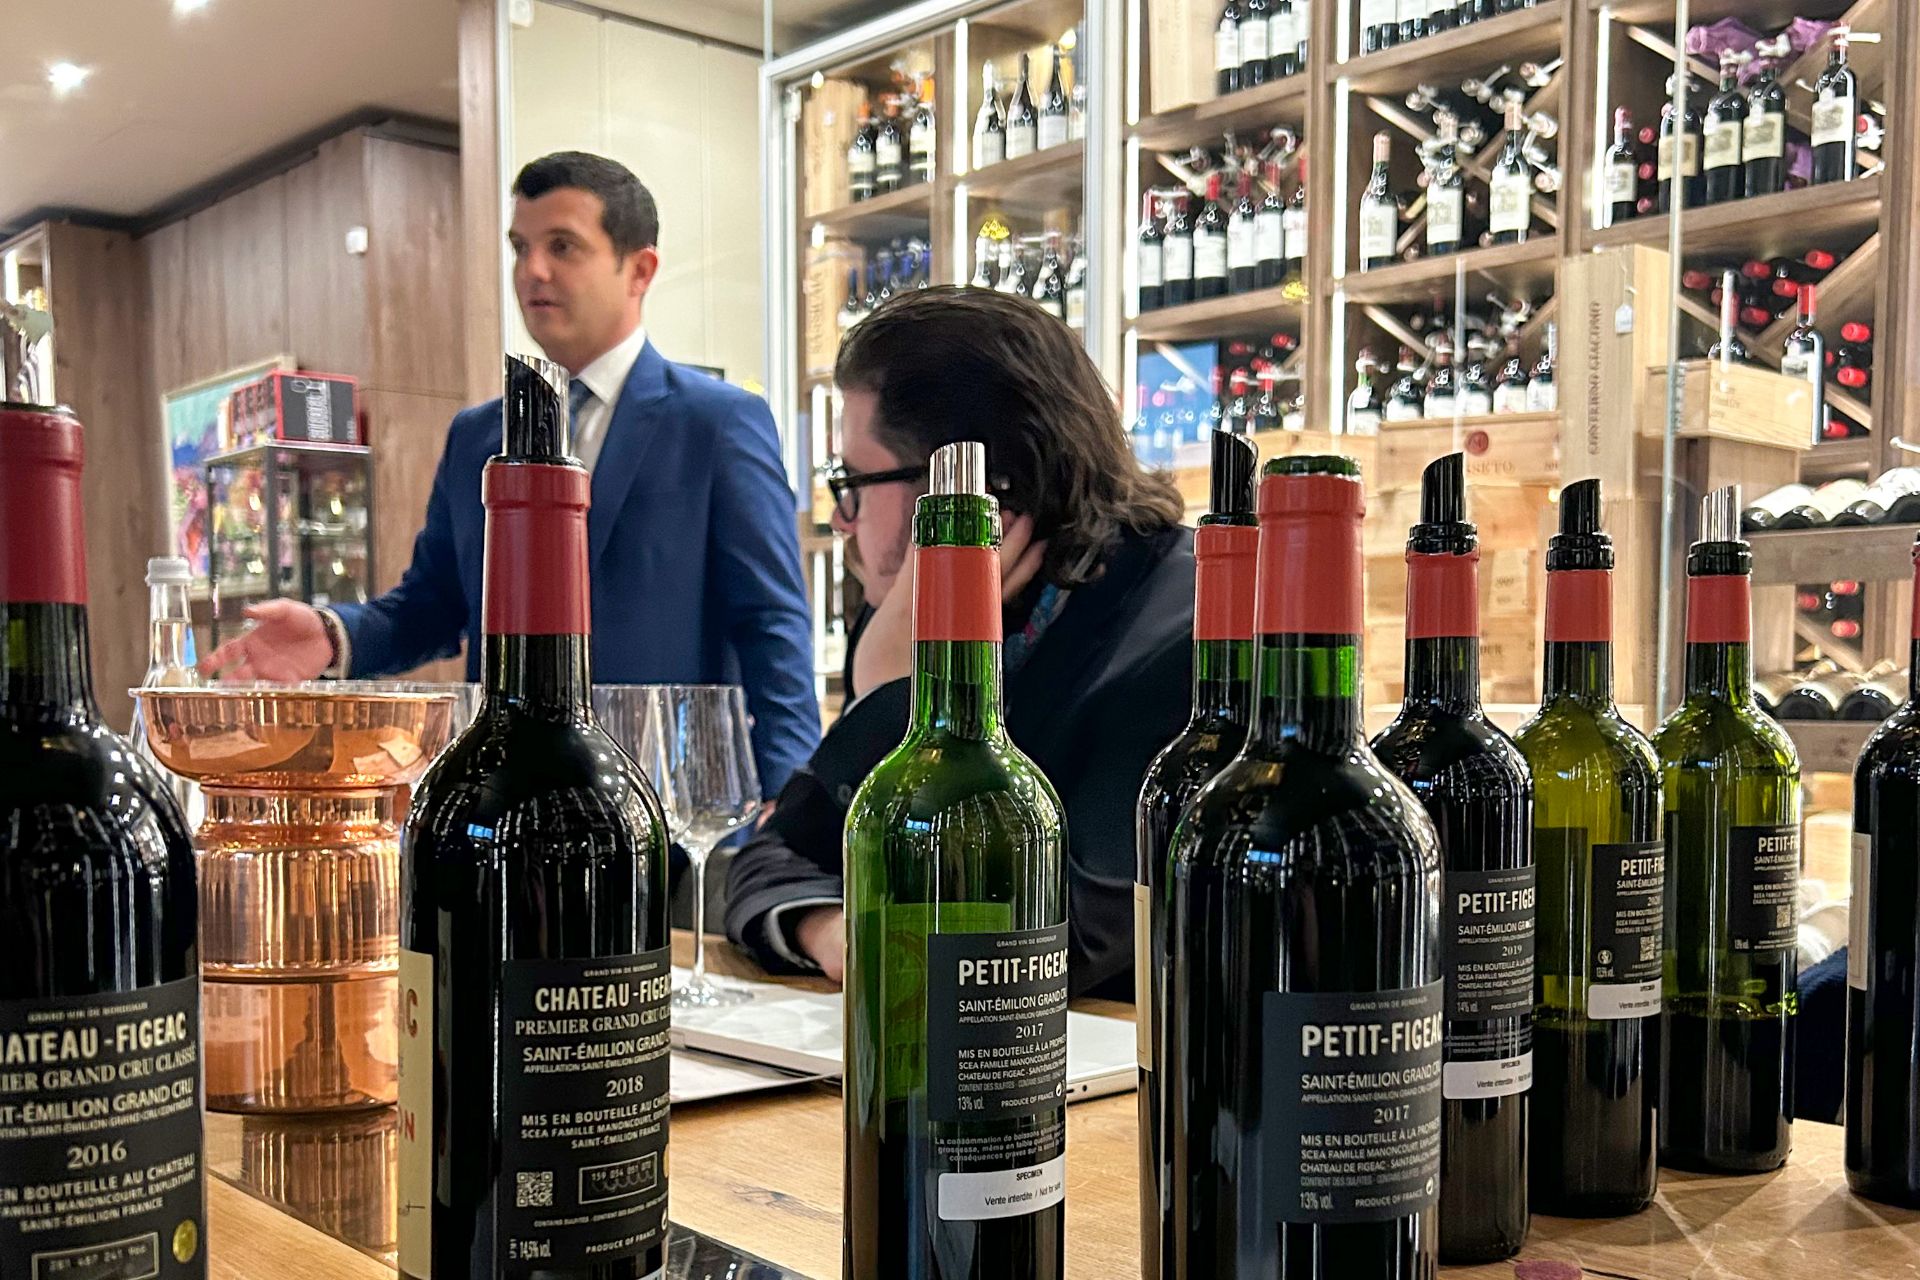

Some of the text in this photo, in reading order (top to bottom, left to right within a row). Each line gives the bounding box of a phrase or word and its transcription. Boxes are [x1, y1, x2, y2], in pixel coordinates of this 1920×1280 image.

[996, 939, 1018, 948] GRAND
[1502, 944, 1522, 956] 2019
[1458, 963, 1471, 972] MIS
[1473, 963, 1483, 972] EN
[959, 989, 1060, 1012] SAINT-ÉMILION GRAND
[515, 1018, 589, 1036] PREMIER
[592, 1012, 639, 1032] GRAND
[959, 1014, 998, 1023] APPELLATION
[1015, 1023, 1044, 1039] 2017
[523, 1042, 635, 1061] SAINT-ÉMILION
[958, 1049, 975, 1059] MIS
[977, 1048, 990, 1059] EN
[992, 1043, 1034, 1057] BOUTEILLE
[1041, 1041, 1049, 1051] LA
[523, 1057, 633, 1074] APPELLATION SAINT-ÉMILION
[958, 1058, 1008, 1070] SCEA FAMILLE
[43, 1064, 116, 1090] GRAND
[119, 1057, 154, 1081] CRU
[958, 1071, 991, 1081] CHATEAU
[992, 1070, 1001, 1080] DE
[1002, 1068, 1025, 1079] FIGEAC
[1301, 1071, 1400, 1089] SAINT-ÉMILION
[1402, 1064, 1431, 1085] GRAND
[112, 1085, 171, 1112] GRAND
[171, 1076, 194, 1100] CRU
[606, 1075, 644, 1098] 2018
[958, 1096, 973, 1110] 13%
[1001, 1091, 1054, 1107] PRODUCE OF FRANCE
[1301, 1093, 1351, 1104] APPELLATION
[521, 1113, 547, 1126] MIS
[552, 1113, 571, 1125] EN
[574, 1103, 638, 1124] BOUTEILLE
[640, 1100, 652, 1112] AU
[1373, 1104, 1410, 1124] 2017
[521, 1128, 549, 1140] SCEA
[551, 1125, 595, 1138] FAMILLE
[571, 1121, 661, 1149] SAINT-ÉMILION FRANCE
[1301, 1134, 1322, 1146] MIS
[1324, 1134, 1341, 1146] EN
[1344, 1130, 1397, 1146] BOUTEILLE
[1406, 1127, 1416, 1139] LA
[67, 1139, 128, 1170] 2016
[1301, 1148, 1364, 1160] SCEA FAMILLE
[1016, 1168, 1043, 1181] SPECIMEN
[1300, 1162, 1340, 1173] CHATEAU
[1343, 1161, 1356, 1172] DE
[1357, 1160, 1386, 1172] FIGEAC
[23, 1175, 118, 1202] BOUTEILLE
[122, 1169, 144, 1188] AU
[121, 1196, 163, 1217] FRANCE
[984, 1195, 1006, 1206] Vente
[1007, 1191, 1032, 1203] interdite
[1300, 1191, 1319, 1210] 13%
[1355, 1189, 1423, 1208] PRODUCE OF FRANCE
[586, 1228, 657, 1255] PRODUCE OF FRANCE
